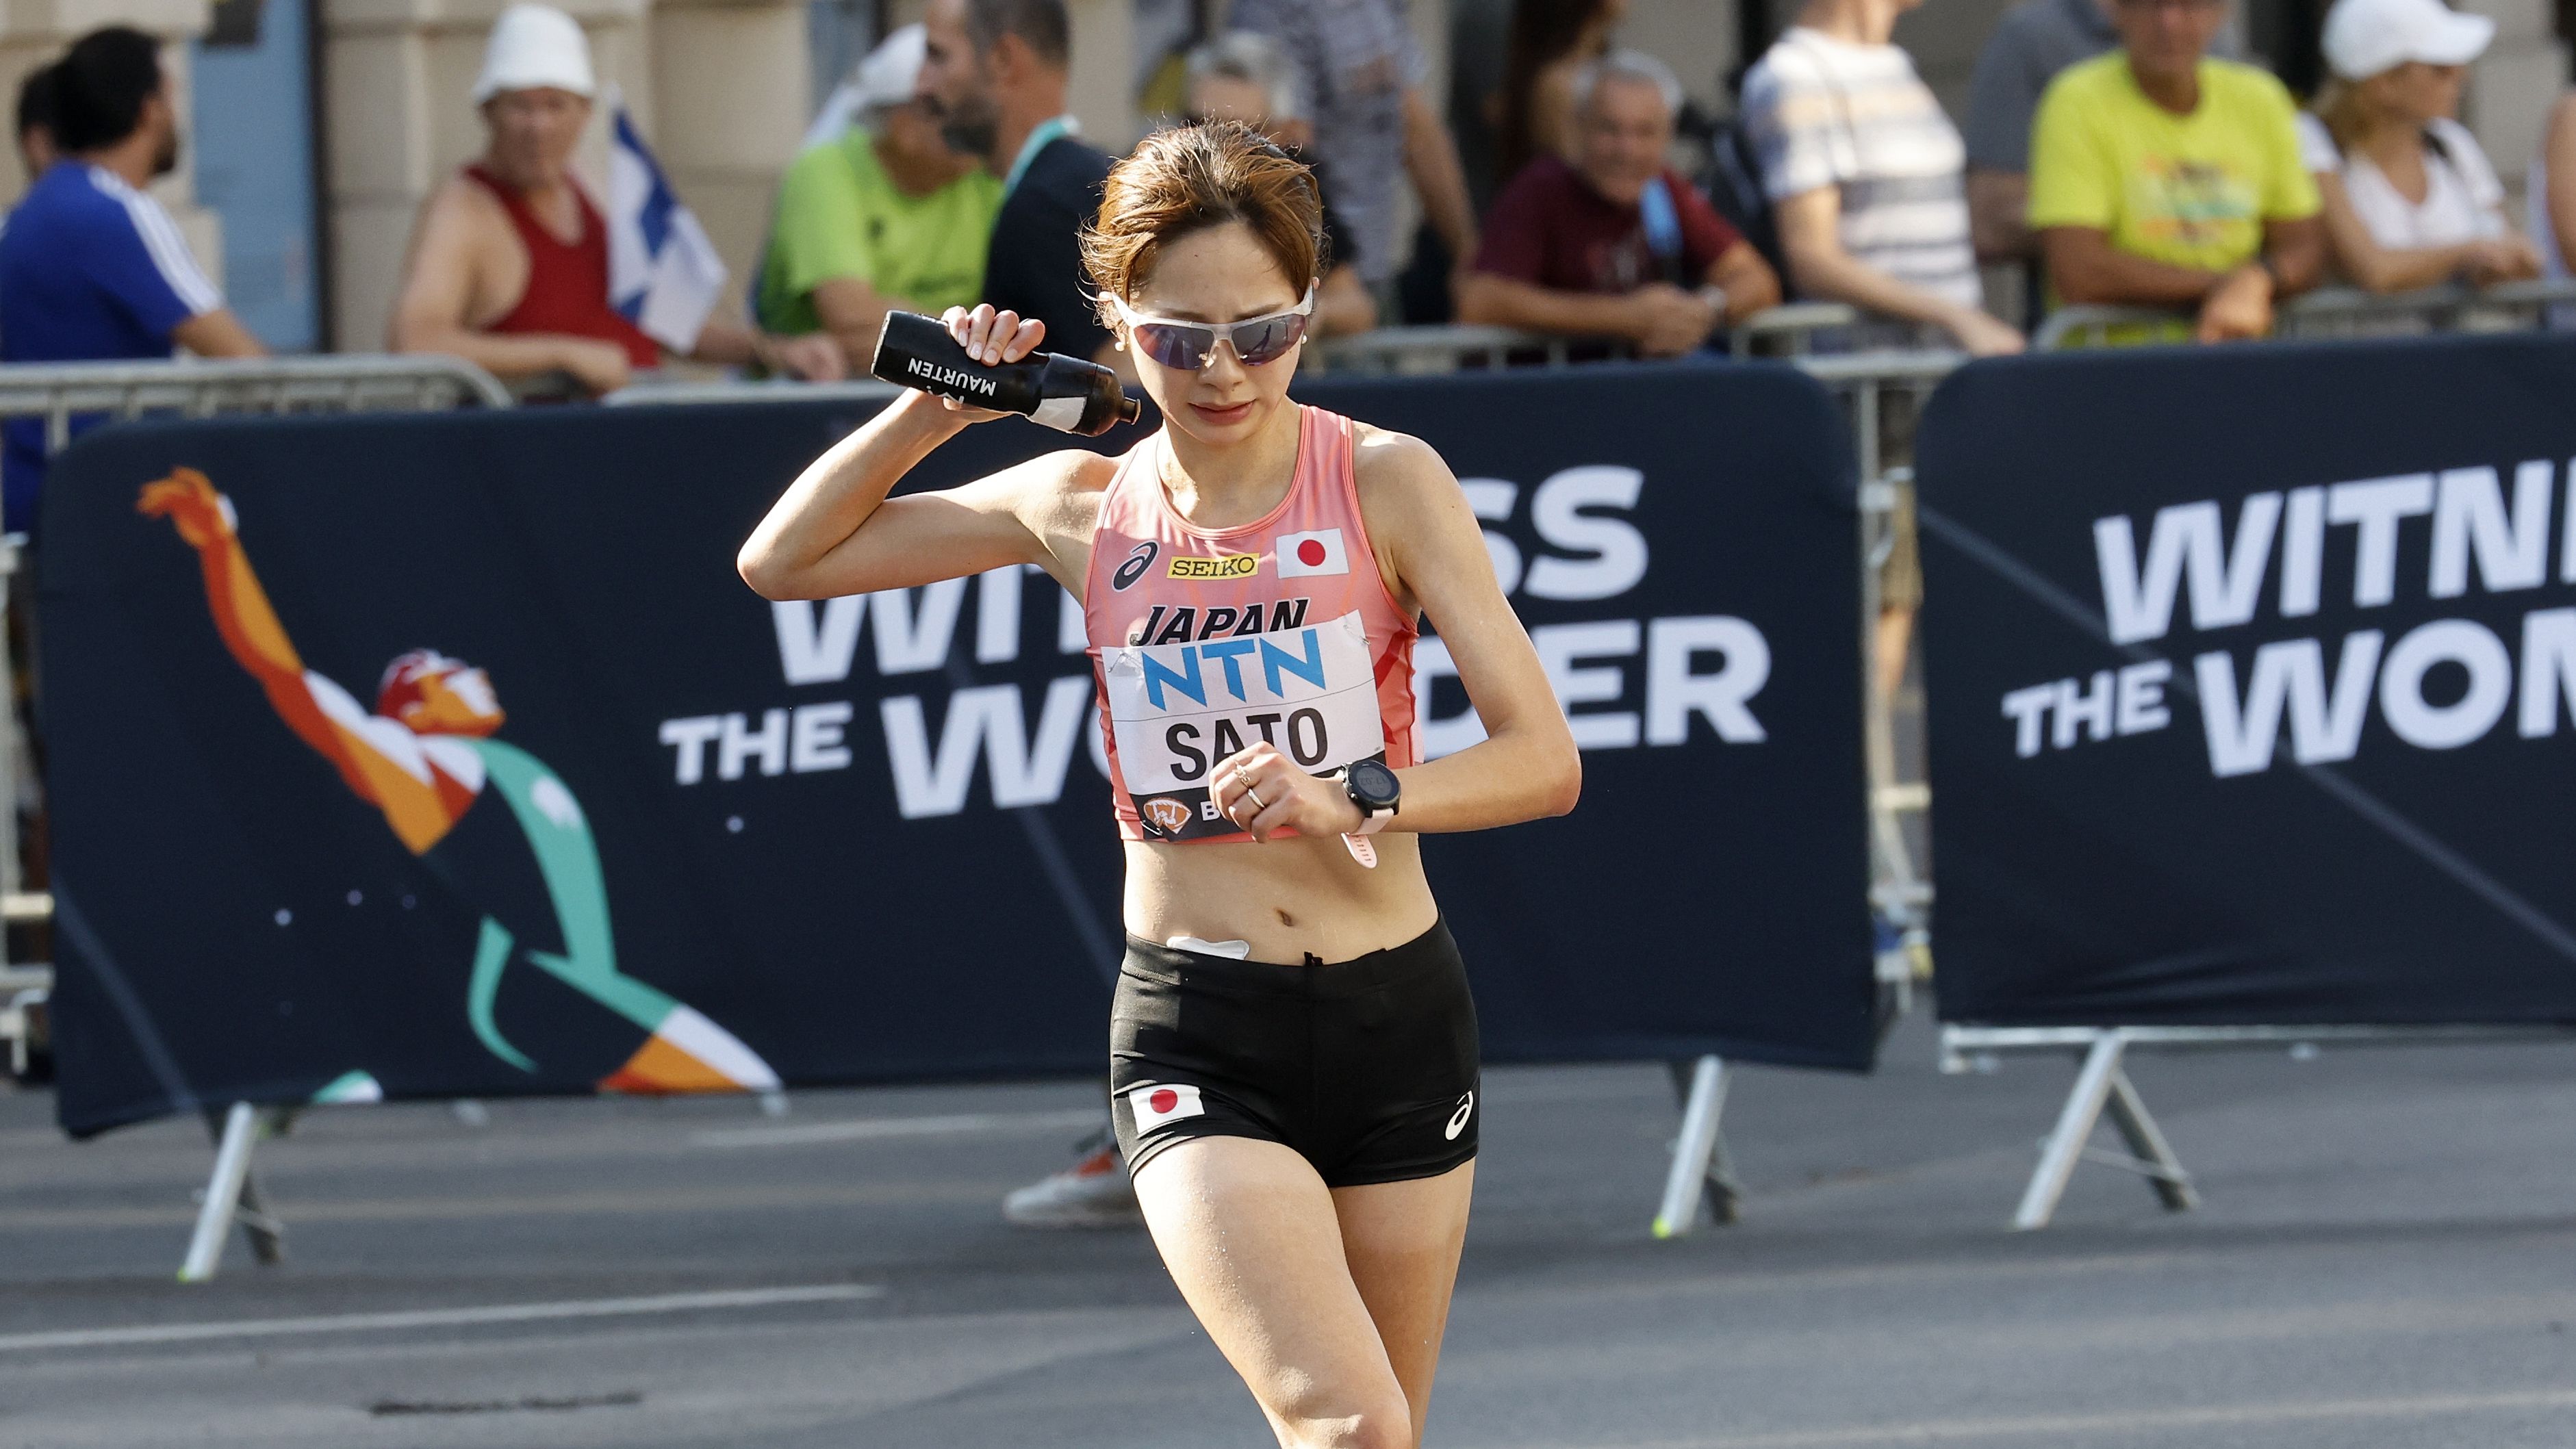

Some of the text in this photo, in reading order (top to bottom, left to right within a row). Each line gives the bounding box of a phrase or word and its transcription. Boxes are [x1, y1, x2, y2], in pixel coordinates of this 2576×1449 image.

[908, 357, 997, 396] MAURTEN
[1171, 556, 1255, 576] SEIKO
[2093, 454, 2576, 645] WITN
[1131, 598, 1310, 647] JAPAN
[1142, 628, 1326, 711] NTN
[2001, 659, 2172, 758] THE
[659, 615, 1772, 820] THE WER
[1165, 707, 1329, 782] SATO
